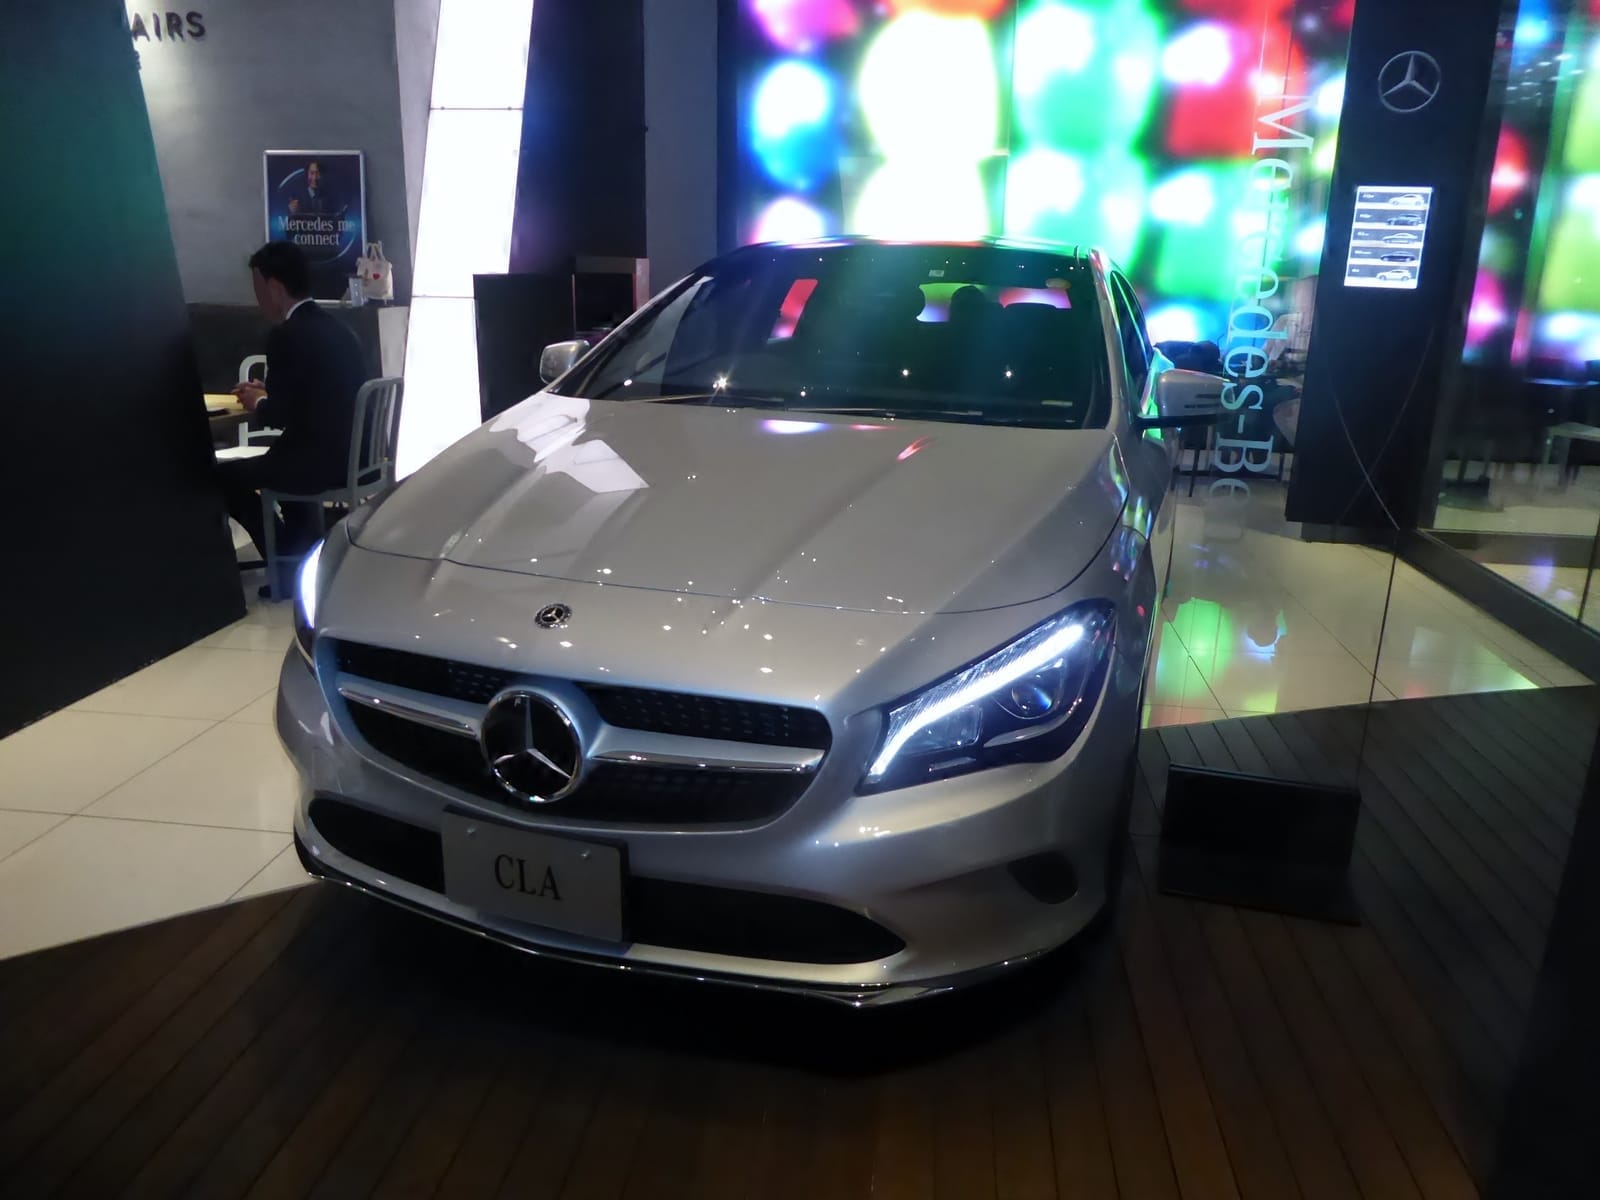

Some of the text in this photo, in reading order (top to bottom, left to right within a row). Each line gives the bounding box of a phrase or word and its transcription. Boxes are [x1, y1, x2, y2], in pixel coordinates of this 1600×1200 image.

[277, 215, 356, 232] Mercedes me
[294, 232, 341, 246] connect
[494, 853, 563, 901] CLA
